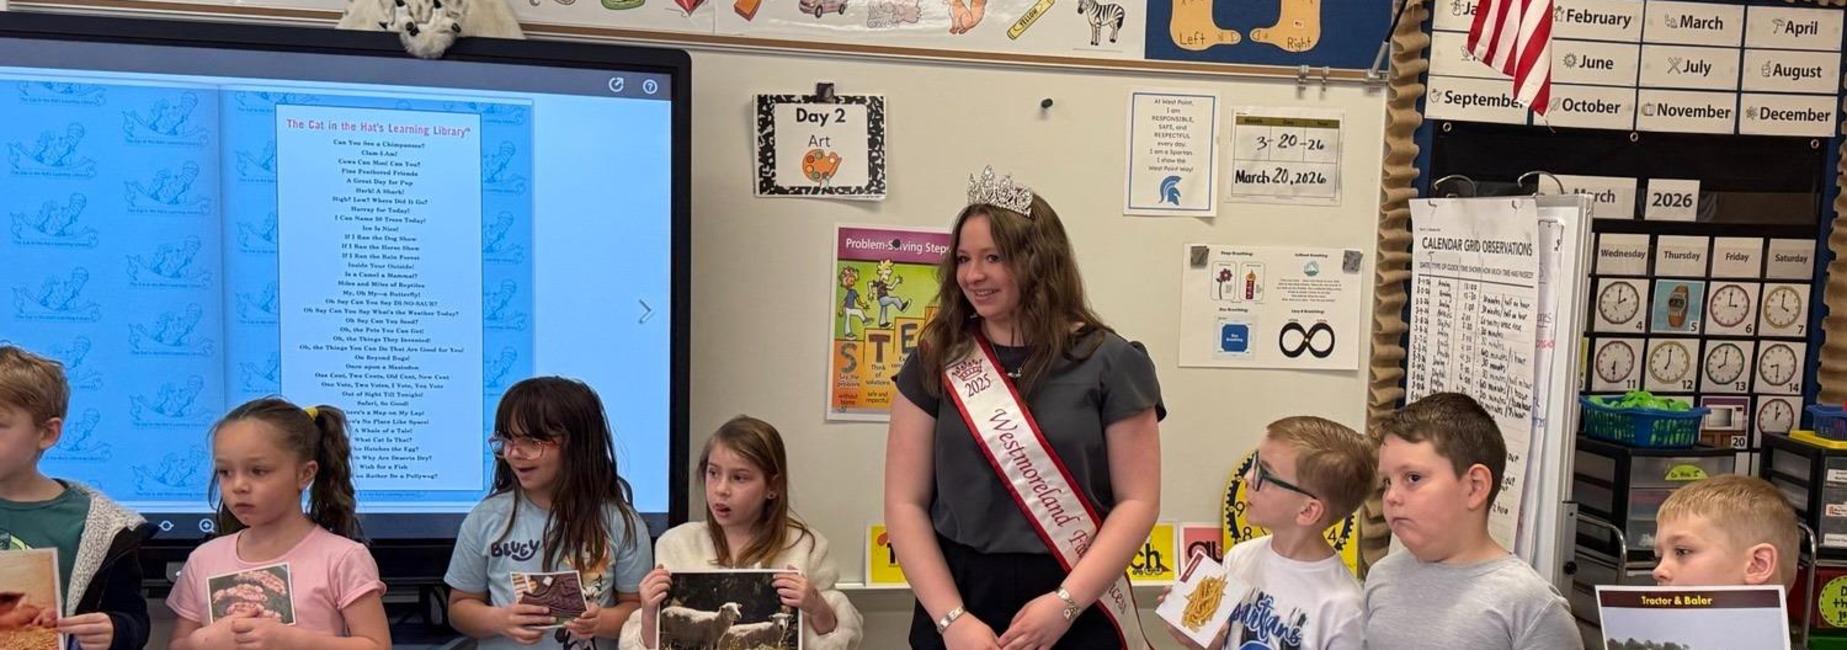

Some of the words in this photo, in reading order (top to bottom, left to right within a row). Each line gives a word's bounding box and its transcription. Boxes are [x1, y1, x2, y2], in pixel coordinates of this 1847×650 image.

[1566, 9, 1632, 29] February
[1680, 14, 1723, 30] March
[1785, 20, 1818, 37] April
[1179, 31, 1206, 45] Left
[1287, 36, 1312, 51] Right
[1579, 54, 1614, 70] June
[1683, 59, 1712, 77] July
[1772, 63, 1822, 81] August
[1562, 97, 1621, 114] October
[1657, 102, 1731, 119] November
[796, 108, 829, 127] Day
[835, 108, 846, 123] 2
[1760, 106, 1831, 122] December
[286, 119, 304, 129] The
[308, 120, 324, 130] Cat
[328, 120, 337, 130] in
[341, 121, 356, 131] the
[360, 122, 384, 132] Hat's
[388, 123, 429, 137] Learning
[808, 135, 831, 148] Art
[1277, 133, 1298, 148] 20
[1235, 169, 1270, 184] March
[1574, 188, 1615, 203] Mrch
[1652, 193, 1692, 208] 2026
[846, 238, 922, 255] Problem-Slving
[1422, 236, 1462, 251] CALENDAR
[1464, 240, 1481, 253] GRID
[1482, 240, 1532, 257] OBSERVATIONS
[1600, 249, 1646, 262] Wednesday
[1664, 250, 1700, 262] Thursday
[1726, 252, 1750, 263] Friday
[1775, 254, 1808, 264] Saturday
[1636, 321, 1643, 330] 4
[1690, 322, 1697, 332] 5
[1745, 323, 1752, 333] 6
[1797, 324, 1804, 334] 7
[868, 334, 890, 363] T
[840, 343, 858, 373] S
[964, 373, 991, 397] 2025
[1626, 379, 1636, 389] 11
[1682, 379, 1693, 390] 12
[1735, 381, 1746, 391] 13
[1788, 383, 1799, 393] 14
[1733, 438, 1745, 446] 20
[989, 408, 1081, 528] Westmoreland
[1235, 501, 1246, 517] 9
[1327, 528, 1336, 542] 4
[490, 540, 540, 561] BLUEY
[1641, 596, 1672, 606] Tractor
[1674, 596, 1682, 606] &
[1684, 596, 1712, 606] Baler
